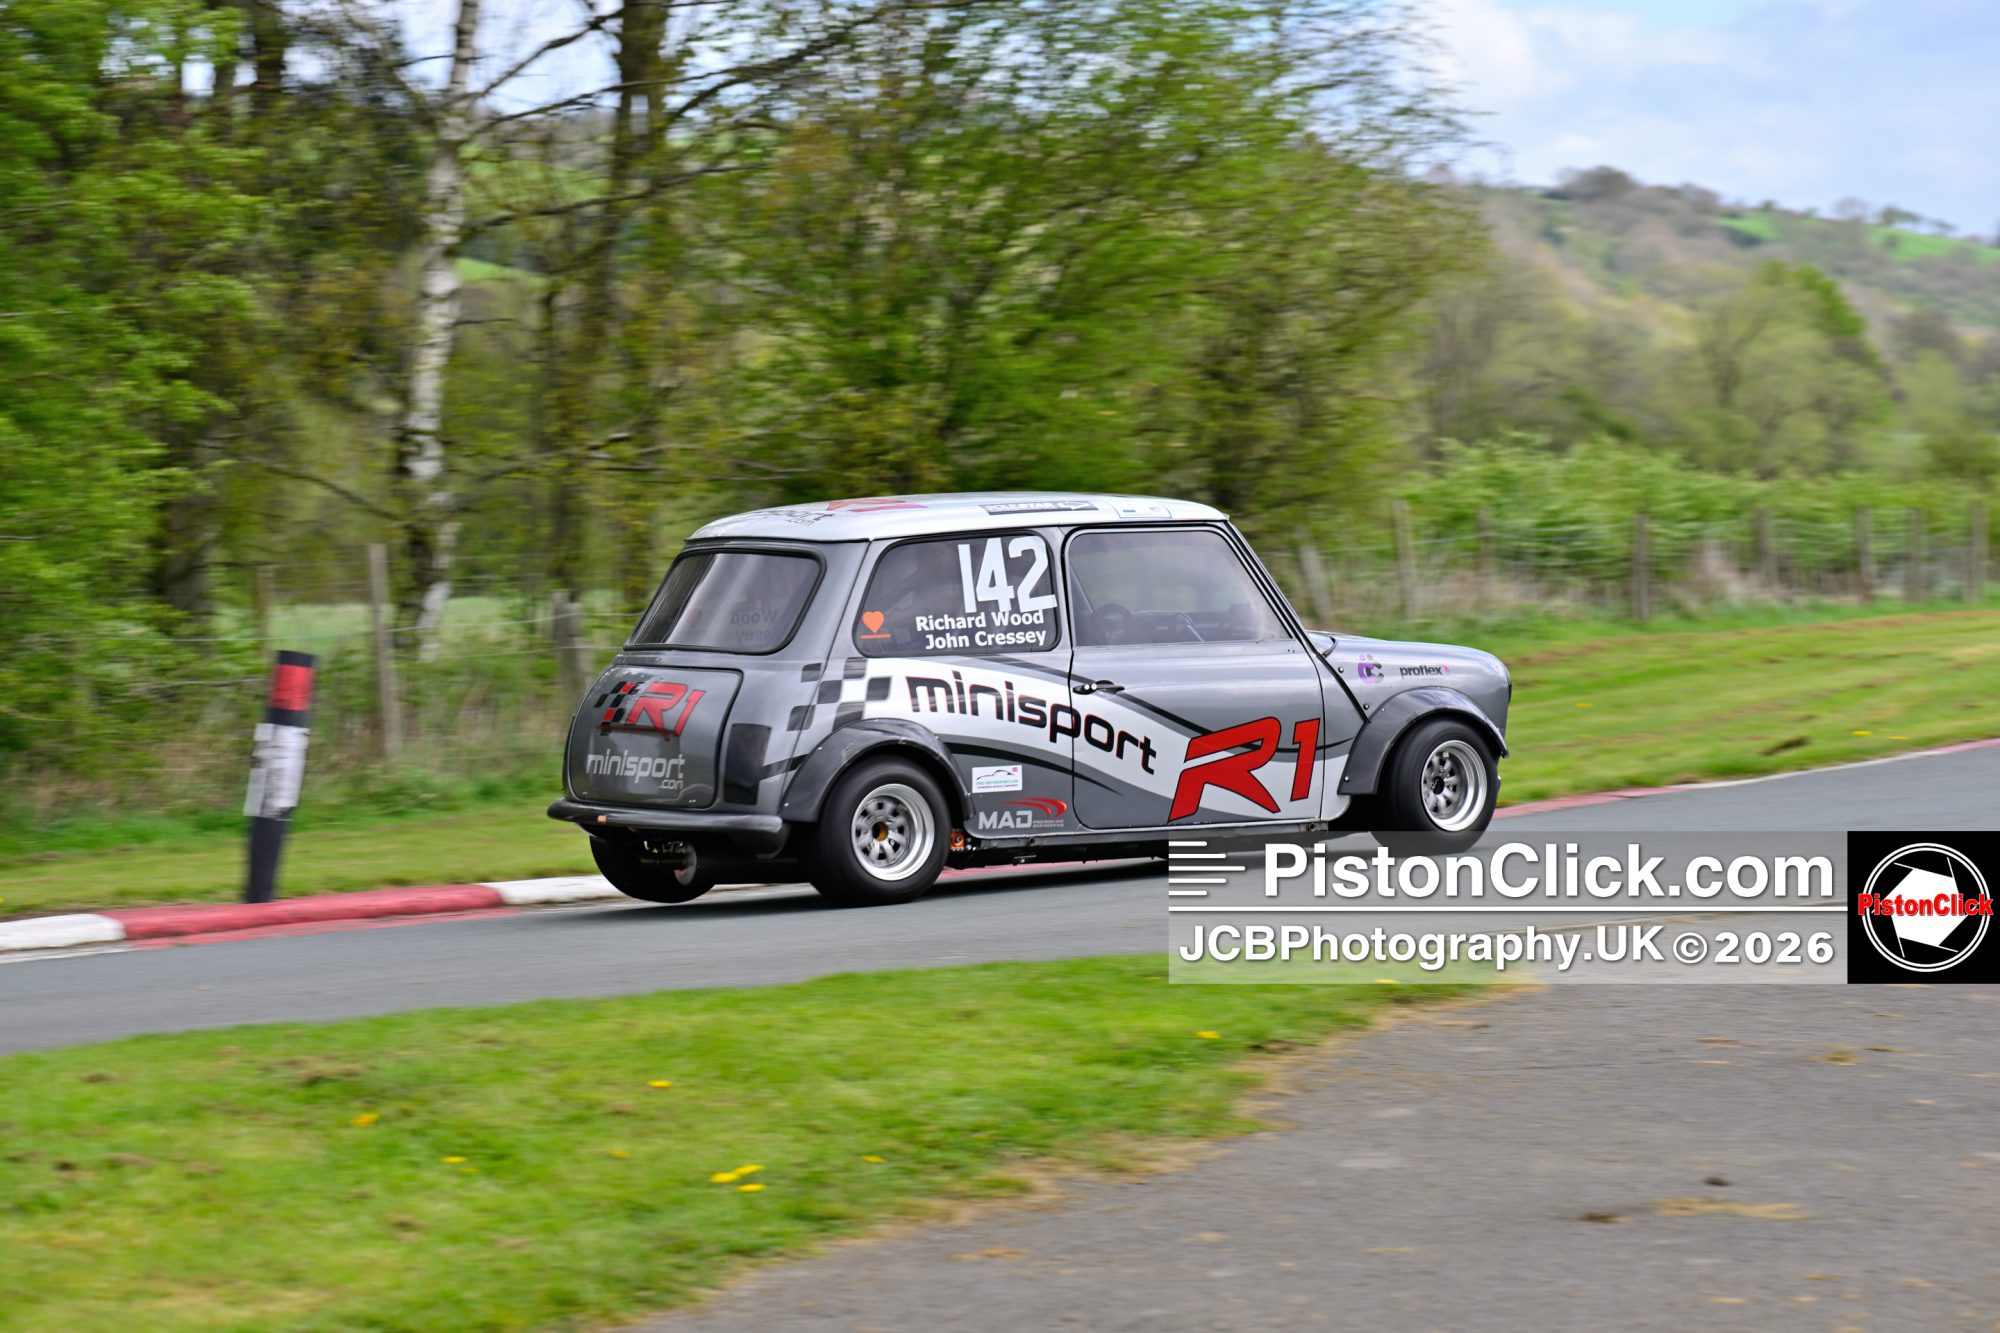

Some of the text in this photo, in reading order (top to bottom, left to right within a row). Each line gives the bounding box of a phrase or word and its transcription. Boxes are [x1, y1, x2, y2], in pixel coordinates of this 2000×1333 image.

[957, 535, 1058, 613] 142
[915, 609, 1045, 632] Richard Wood
[925, 630, 1047, 650] John Cressey
[1400, 664, 1443, 681] proflex
[625, 681, 706, 742] R1
[905, 670, 1157, 775] minisport
[586, 748, 686, 784] minisport
[1167, 716, 1321, 824] R1
[978, 810, 1033, 830] MAD
